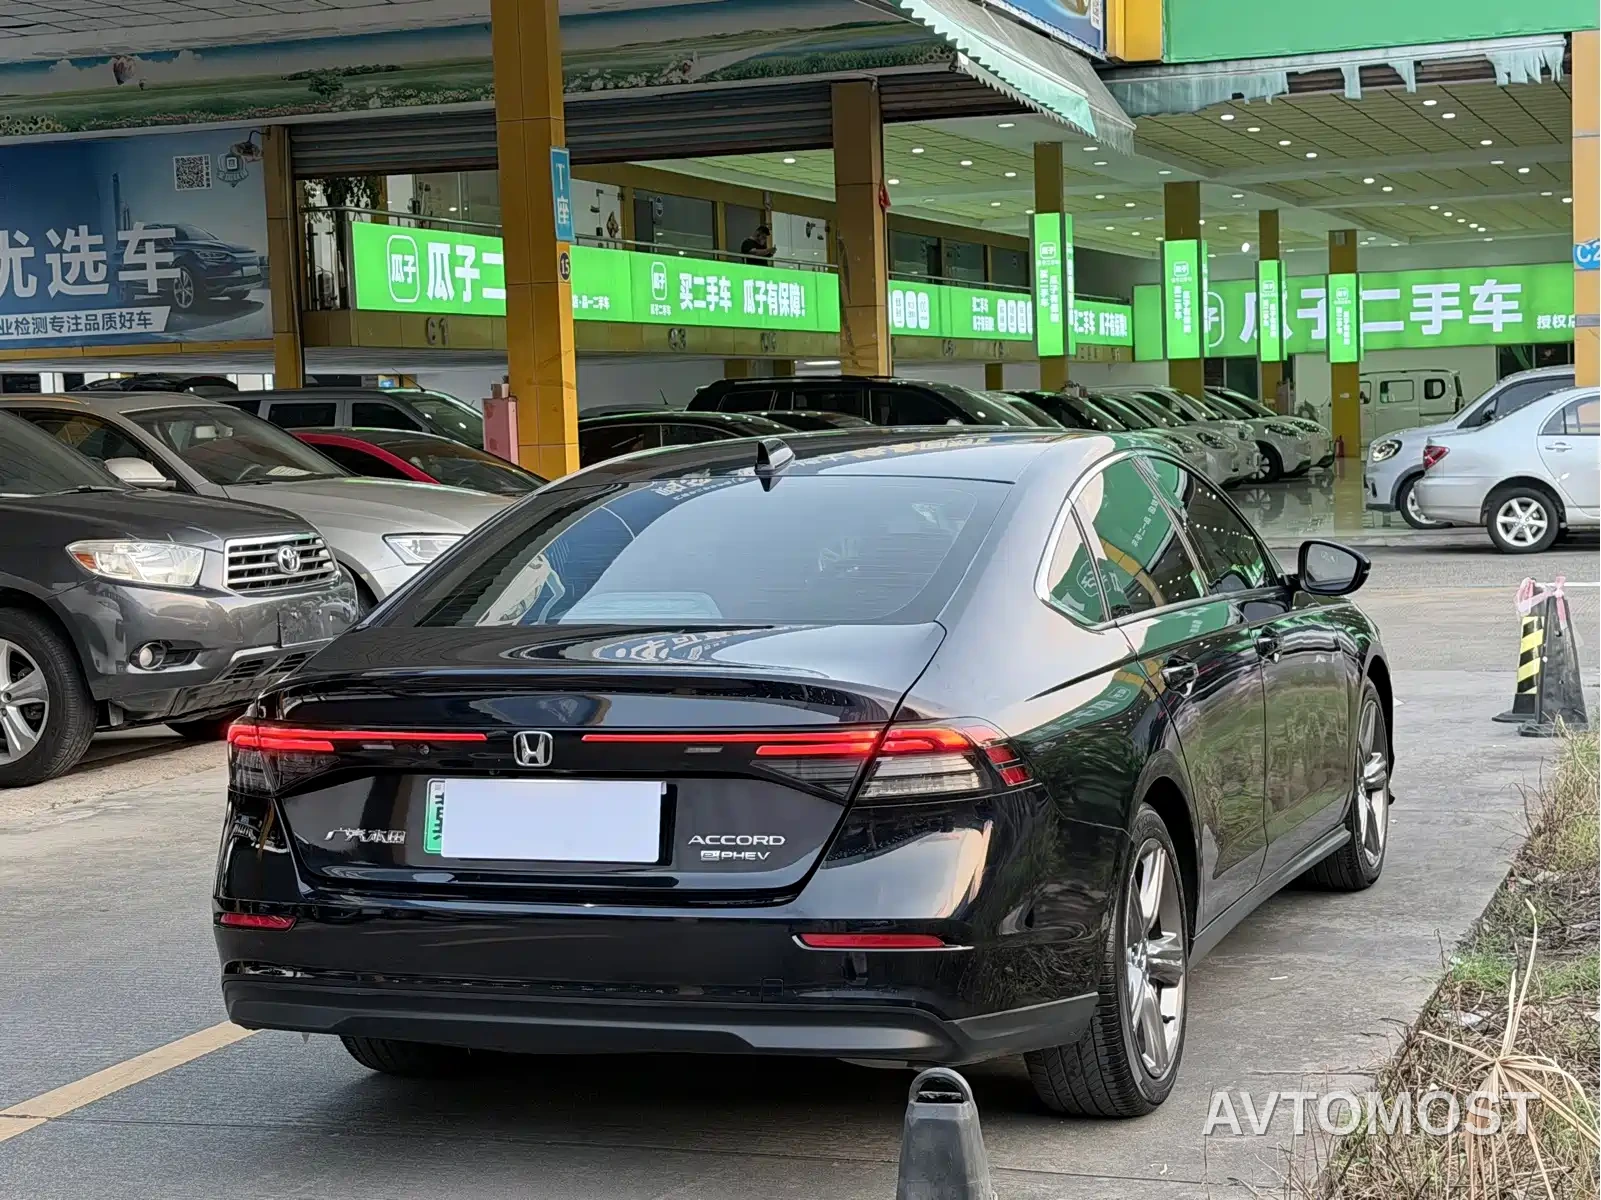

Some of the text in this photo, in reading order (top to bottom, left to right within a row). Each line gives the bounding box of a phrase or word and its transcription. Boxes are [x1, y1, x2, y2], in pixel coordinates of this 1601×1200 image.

[561, 258, 570, 276] 15
[679, 272, 806, 318] 买二手车 瓜子有保障!
[425, 317, 448, 345] C1
[688, 835, 786, 846] ACCORD
